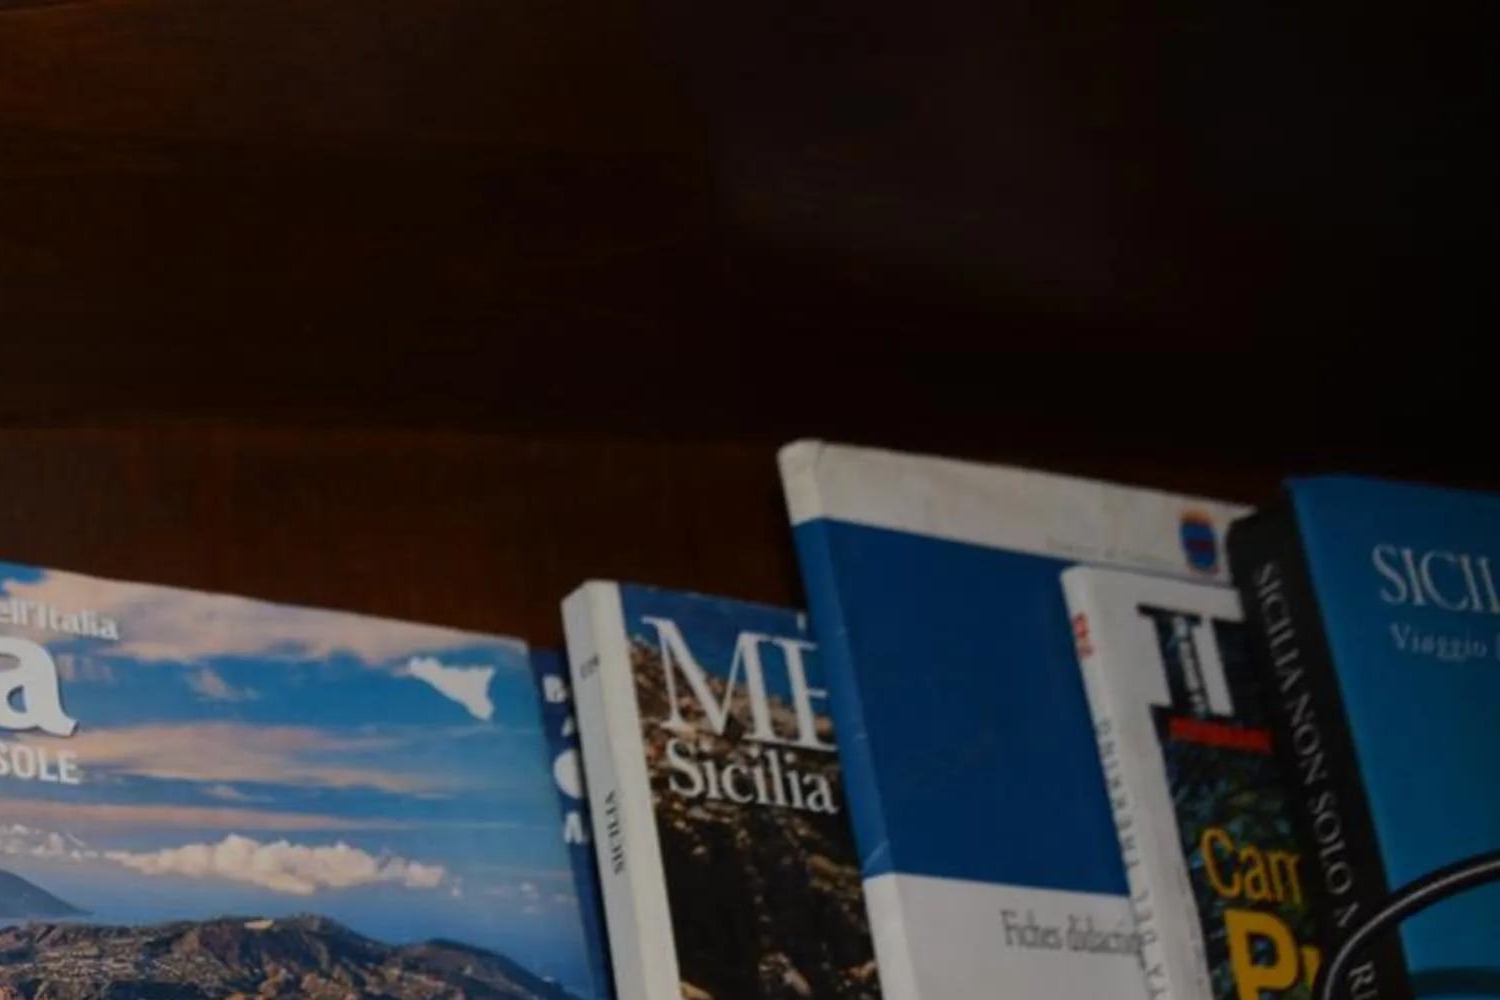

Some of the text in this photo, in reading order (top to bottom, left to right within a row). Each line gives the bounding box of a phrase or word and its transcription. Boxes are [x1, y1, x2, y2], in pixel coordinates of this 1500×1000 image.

[1388, 622, 1488, 663] Viaggio
[1257, 562, 1304, 692] SICILIA
[1285, 693, 1328, 786] NON
[1309, 790, 1354, 896] SOLO
[666, 737, 839, 815] Sicilia
[603, 789, 627, 877] SICILIA
